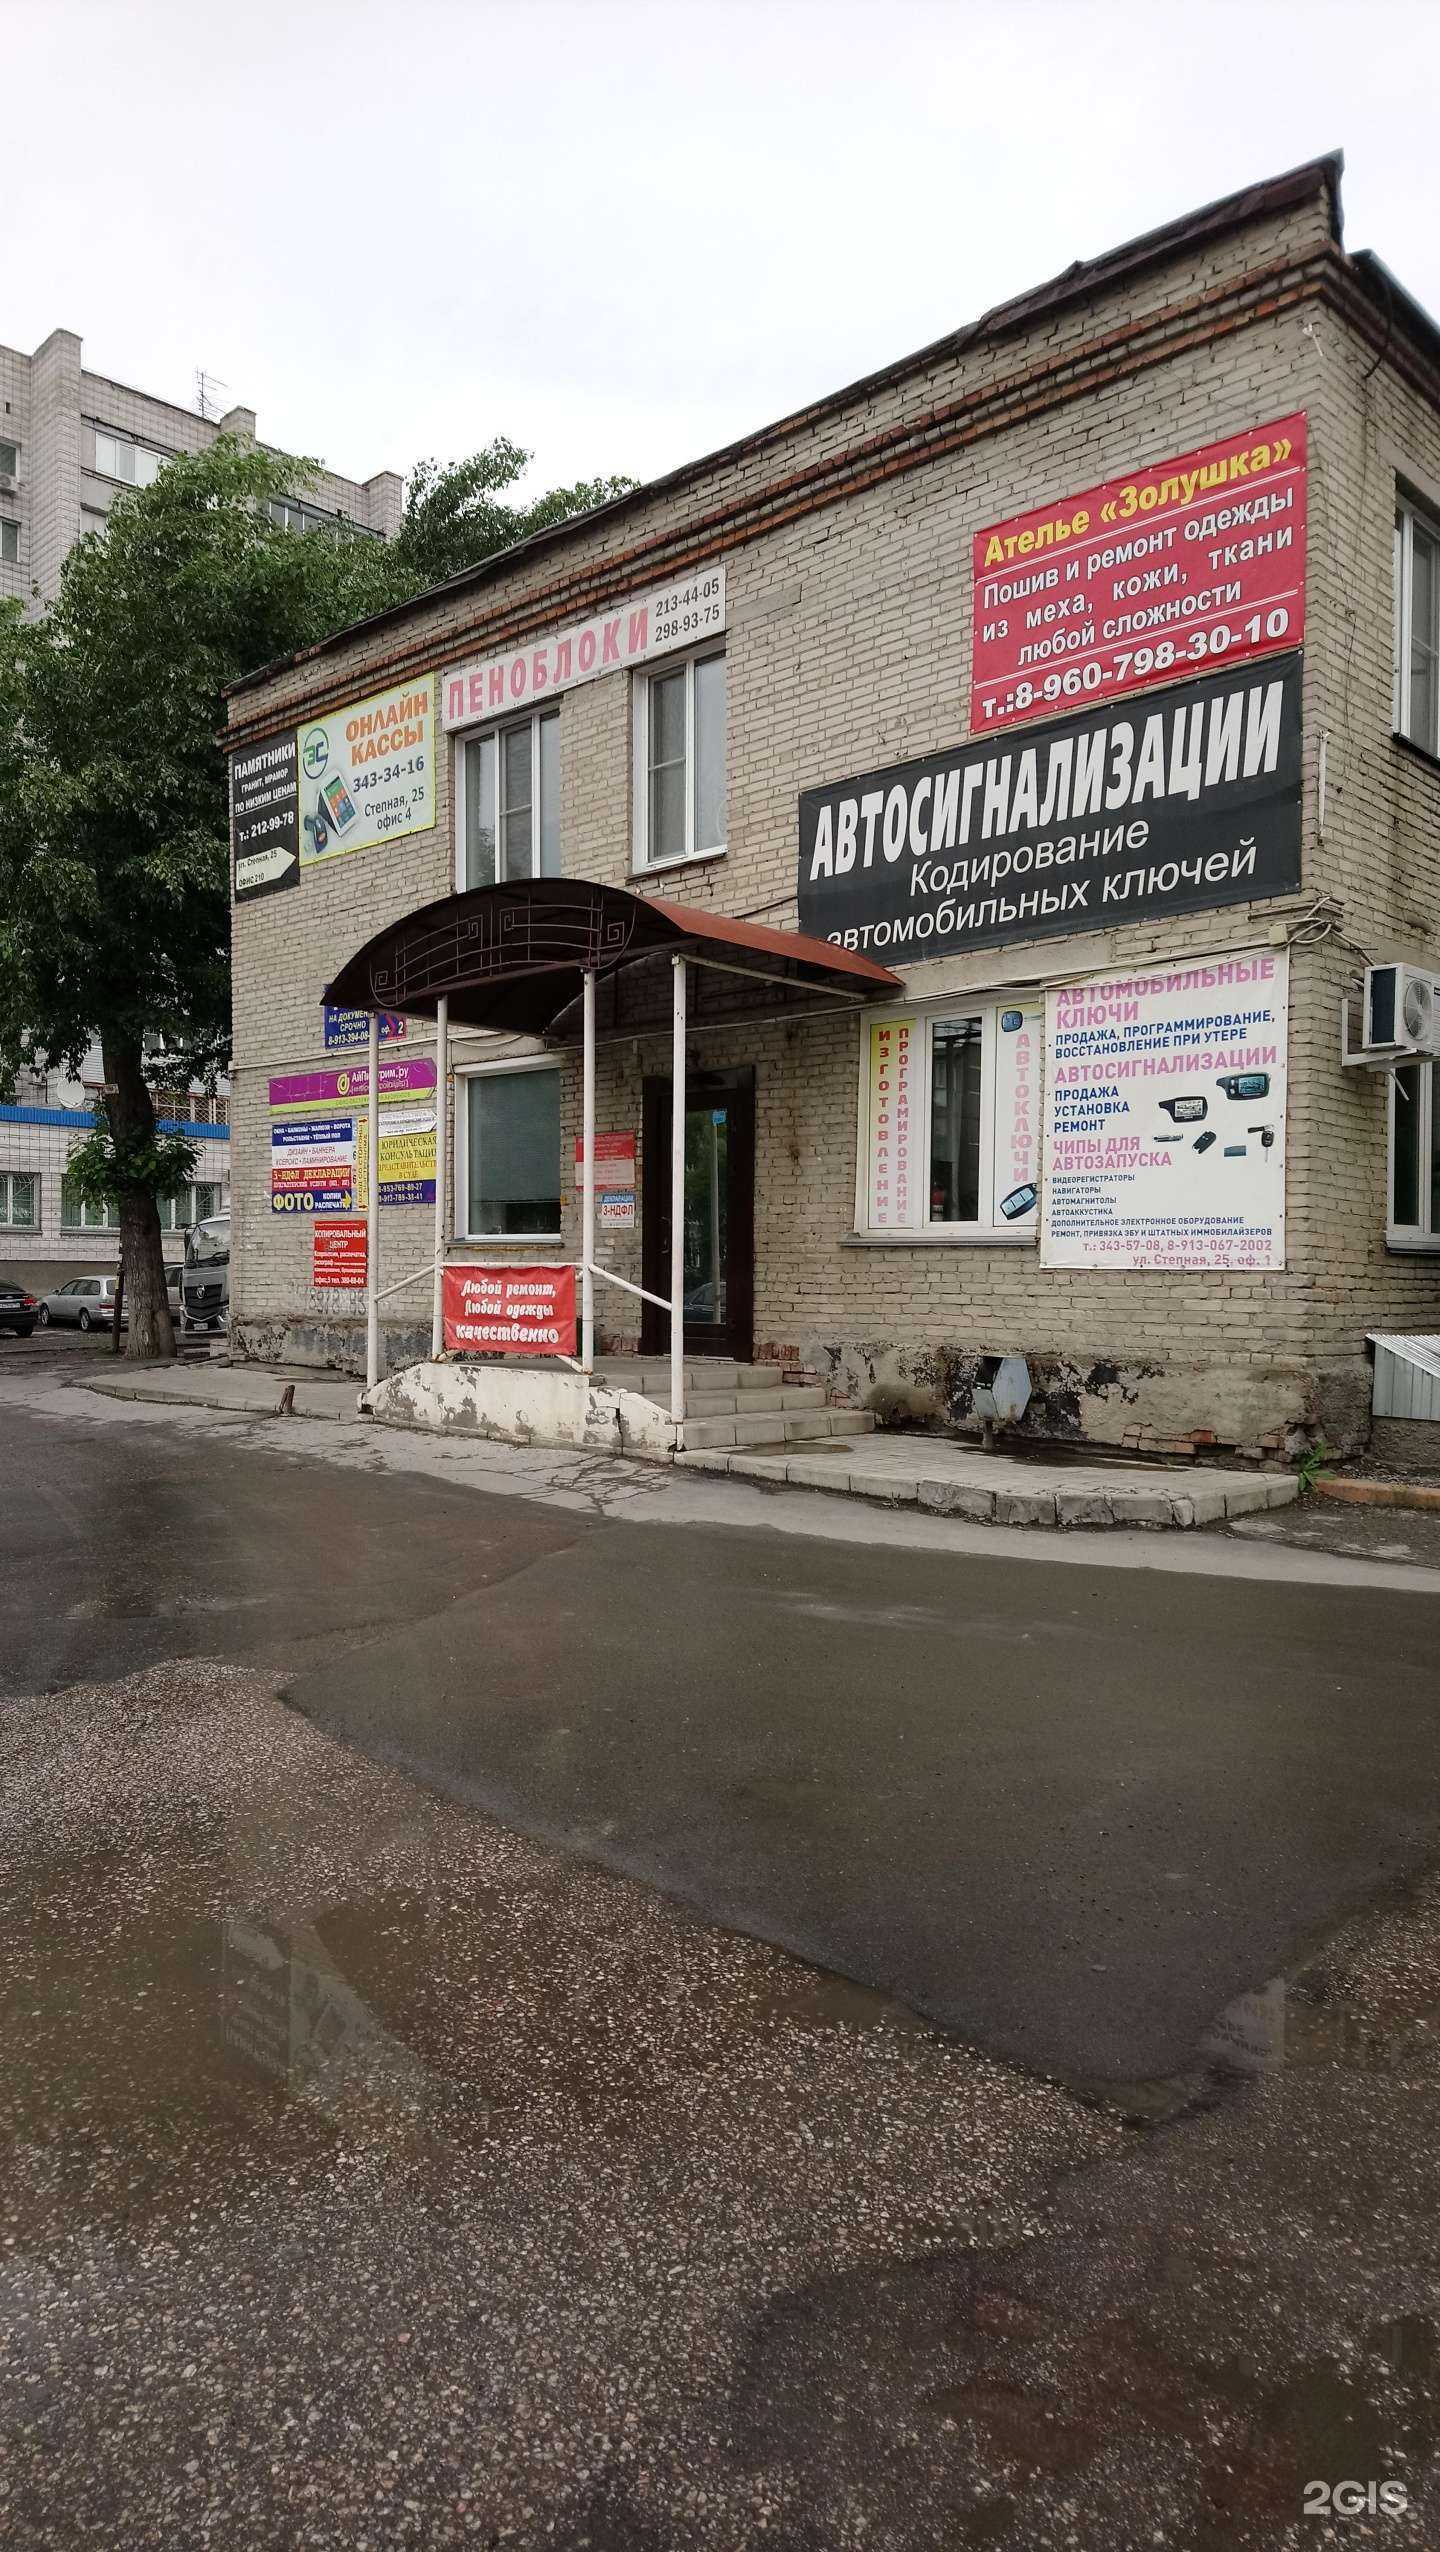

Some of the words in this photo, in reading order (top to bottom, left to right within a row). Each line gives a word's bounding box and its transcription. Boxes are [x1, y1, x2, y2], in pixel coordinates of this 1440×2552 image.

[984, 510, 1090, 567] Ателье
[1100, 438, 1293, 524] «Золушка»
[983, 569, 1059, 608] Пошив
[1066, 560, 1079, 581] и
[1087, 526, 1177, 580] ремонт
[1184, 487, 1293, 541] одежды
[983, 619, 1008, 642] из
[1026, 593, 1093, 629] меха,
[1112, 563, 1187, 601] кожи,
[1208, 526, 1293, 570] ткани
[655, 577, 719, 617] 213-44-05
[655, 604, 720, 642] 298-93-75
[1018, 619, 1096, 666] любой
[1102, 580, 1241, 639] сложности
[449, 608, 649, 720] ПЕНОБЛОКИ
[346, 691, 429, 742] ОНЛАЙН
[352, 720, 424, 767] КАССЫ
[234, 741, 296, 780] ПАМЯТНИКИ
[241, 777, 265, 794] ГРАНИТ,
[264, 767, 289, 786] МРАМОР
[353, 755, 425, 793] 343-34-16
[809, 680, 1285, 881] АВТОСИГНАЛИЗАЦИИ
[235, 801, 244, 814] ПО
[246, 791, 272, 810] НИЗКИМ
[273, 781, 297, 800] ЦЕНАМ
[364, 793, 408, 817] Степная,
[412, 787, 425, 802] 25
[251, 811, 294, 838] 212-99-78
[377, 812, 403, 831] офис
[405, 807, 412, 821] 4
[910, 819, 1149, 897] Кодирование
[825, 879, 1091, 950] автомобильных
[1102, 837, 1257, 903] ключей
[328, 1013, 337, 1023] НА
[338, 1010, 368, 1023] ДОКУМЕН
[340, 1020, 366, 1032] СРОЧНО
[1056, 1001, 1139, 1030] КЛЮЧИ
[398, 1021, 404, 1034] 2
[1055, 1029, 1120, 1046] ПРОДАЖА,
[1123, 1009, 1275, 1038] ПРОГРАММИРОВАНИЕ,
[1055, 1036, 1170, 1059] ВОССТАНОВЛЕНИЕ
[1173, 1032, 1201, 1047] ПРИ
[1204, 1027, 1247, 1044] УТЕРЕ
[1054, 1045, 1277, 1084] АВТОСИГНАЛИЗАЦИИ
[1055, 1085, 1119, 1102] ПРОДАЖА
[1011, 1033, 1033, 1182] АВТОКЛЮЧИ
[1054, 1101, 1130, 1118] УСТАНОВКА
[333, 1122, 351, 1130] ВОРОТА
[877, 1030, 890, 1223] ИЗГОТОВЛЕНИЕ
[897, 1027, 909, 1223] ПРОГРАМИРОВАНИЕ
[1053, 1119, 1106, 1133] РЕМОНТ
[381, 1136, 437, 1149] ЮРИДИЧЕСКАЯ
[1053, 1138, 1101, 1155] ЧИПЫ
[1105, 1136, 1140, 1154] ДЛЯ
[380, 1149, 436, 1161] КОНСУЛЬТАЦИ
[1052, 1151, 1172, 1171] АВТОЗАПУСКА
[273, 1170, 300, 1181] 3-НДФЛ
[303, 1167, 350, 1180] ДЕКЛАРАЦИИ
[1052, 1173, 1135, 1184] ВИДЕОРЕГИСТРАТОРЫ
[273, 1192, 314, 1211] ФОТО
[322, 1192, 341, 1200] КОПИИ
[1051, 1196, 1117, 1205] АВТОМАГНИТОЛЫ
[1052, 1186, 1101, 1195] НАВИГАТОРЫ
[603, 1204, 633, 1217] 3-НДФЛ
[1051, 1208, 1113, 1216] АВТОАККУСТИКА
[1051, 1218, 1119, 1227] ДОПОЛНИТЕЛЬНОЕ
[1120, 1216, 1176, 1225] ЭЛЕКТРОННОЕ
[1178, 1216, 1244, 1225] ОБОРУДОВАНИЕ
[314, 1229, 366, 1238] КОПИРОВАЛЬНЫЙ
[1051, 1229, 1082, 1239] РЕМОНТ,
[1083, 1229, 1123, 1238] ПРИВЯЗКА
[1124, 1228, 1139, 1237] ЭБУ
[1148, 1228, 1189, 1236] ШТАТНЫХ
[1190, 1226, 1272, 1236] ИММОБИЛАЙЗЕРОВ
[329, 1240, 348, 1249] ЦЕНТР
[1099, 1240, 1164, 1252] 343-57-08,
[1167, 1239, 1272, 1251] 8-913-067-2002
[1132, 1254, 1147, 1267] ул.
[1153, 1254, 1210, 1267] Степная,
[1237, 1254, 1261, 1268] оф.
[1265, 1255, 1271, 1266] 1
[461, 1279, 502, 1297] Любой
[506, 1283, 556, 1298] ремонт,
[464, 1298, 502, 1316] Любой
[506, 1304, 554, 1320] одежды
[456, 1323, 559, 1343] качественно
